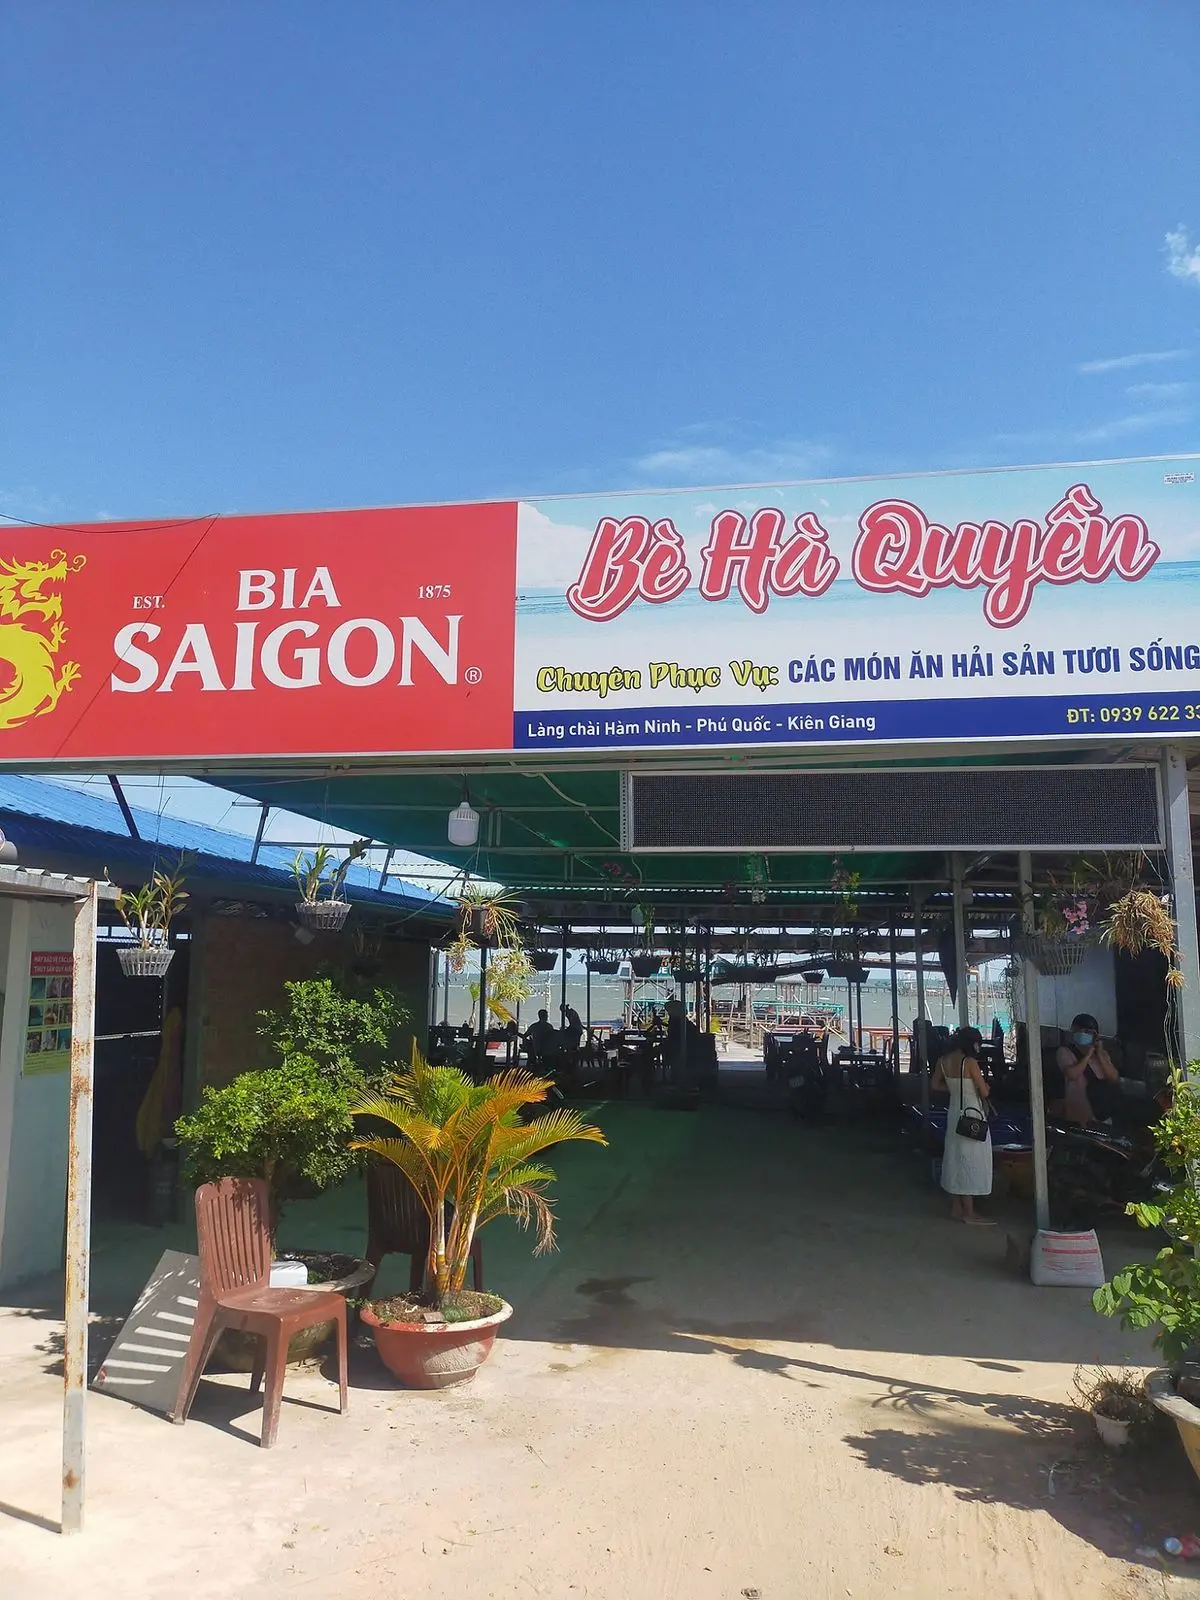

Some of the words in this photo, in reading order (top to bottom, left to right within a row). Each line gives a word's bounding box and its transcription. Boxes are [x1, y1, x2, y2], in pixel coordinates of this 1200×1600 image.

[566, 515, 692, 622] Bè
[699, 507, 840, 614] Hà
[851, 483, 1161, 629] Quyền
[132, 595, 166, 610] EST.
[417, 584, 452, 599] 1875
[235, 566, 342, 611] BIA
[111, 615, 464, 693] SAIGON
[536, 666, 642, 699] Chuyên
[648, 662, 721, 693] Phục
[728, 660, 779, 692] Vụ:
[787, 654, 836, 684] CÁC
[843, 652, 900, 681] MÓN
[908, 650, 944, 679] ĂN
[951, 645, 994, 678] HẢI
[1002, 643, 1056, 676] SẢN
[1062, 645, 1121, 674] TƯƠI
[1129, 637, 1200, 672] SỐNG
[527, 723, 565, 739] Làng
[568, 721, 601, 736] chài
[604, 720, 641, 735] Hàm
[644, 719, 681, 734] Ninh
[697, 717, 728, 732] Phú
[732, 714, 772, 732] Quốc
[787, 715, 825, 731] Kiên
[828, 714, 876, 732] Giang
[1066, 708, 1096, 724] ĐT:
[1100, 706, 1143, 723] 0939
[1148, 705, 1180, 721] 622
